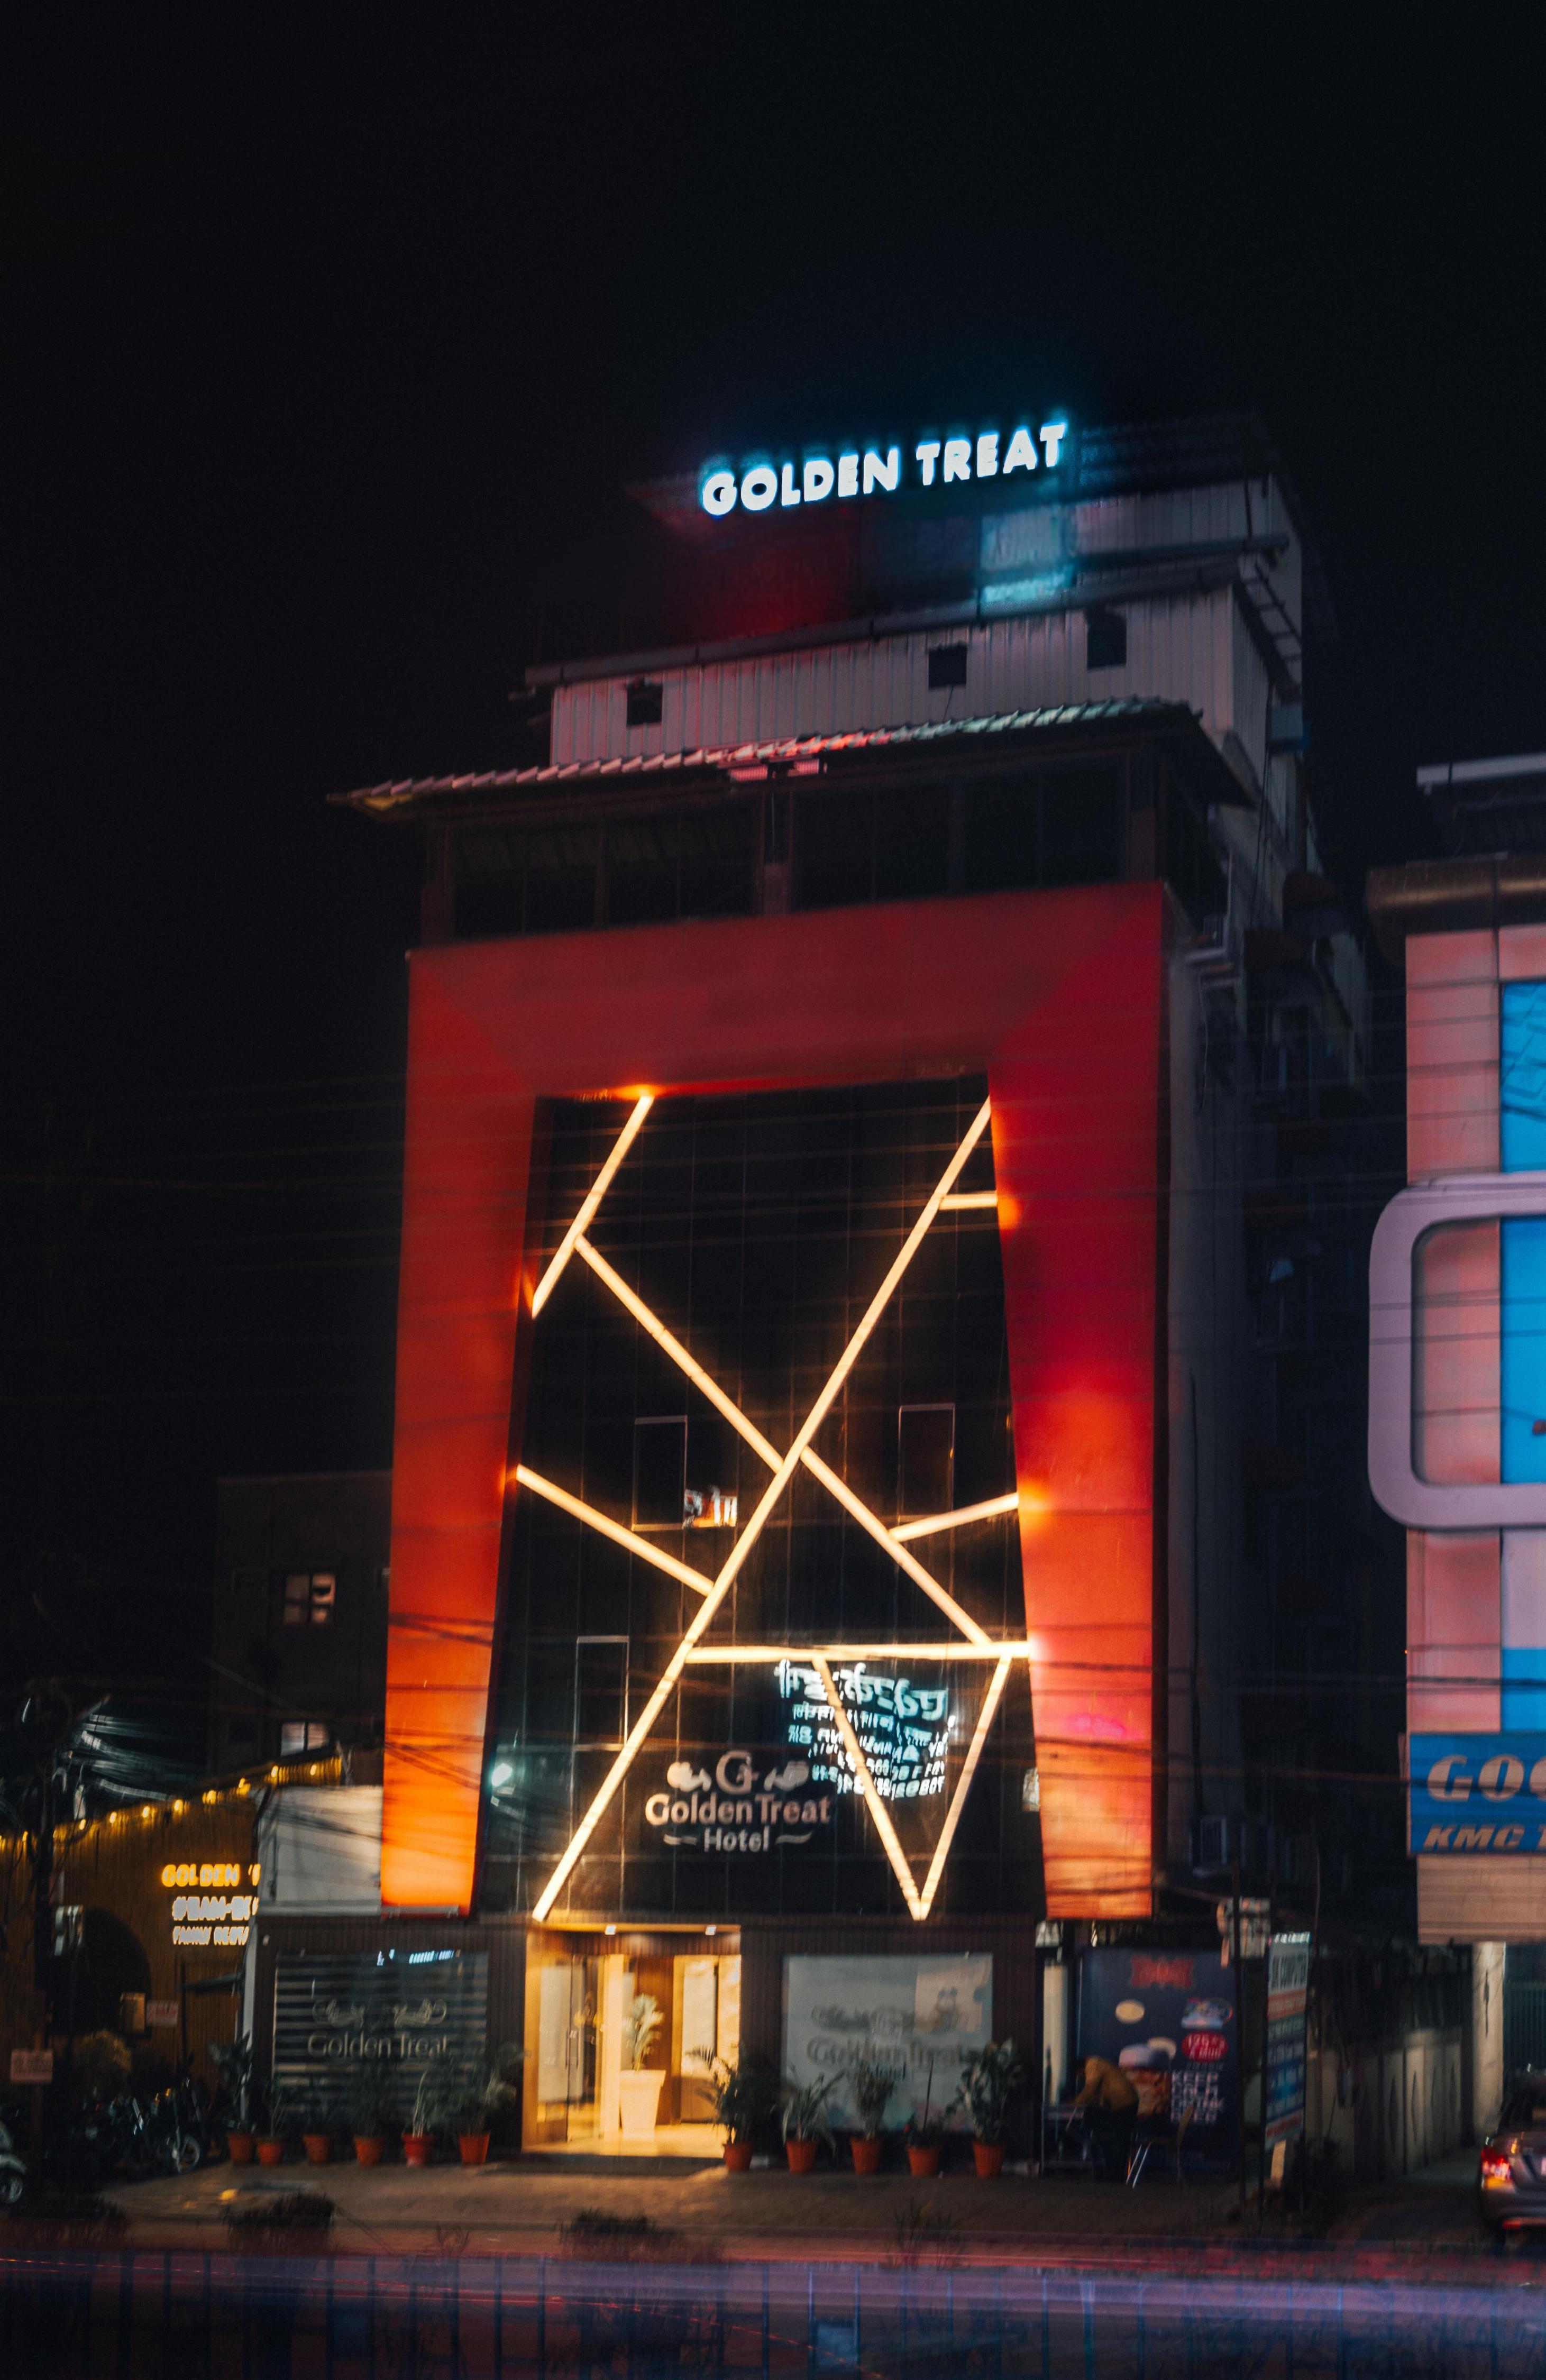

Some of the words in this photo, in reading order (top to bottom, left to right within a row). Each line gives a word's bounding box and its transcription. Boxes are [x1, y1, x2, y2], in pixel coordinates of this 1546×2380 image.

[702, 447, 899, 516] GOLDEN
[917, 423, 1065, 486] TREAT
[703, 1825, 770, 1852] Hotel
[1422, 1825, 1525, 1851] KMC
[161, 1863, 240, 1887] GOLDEN
